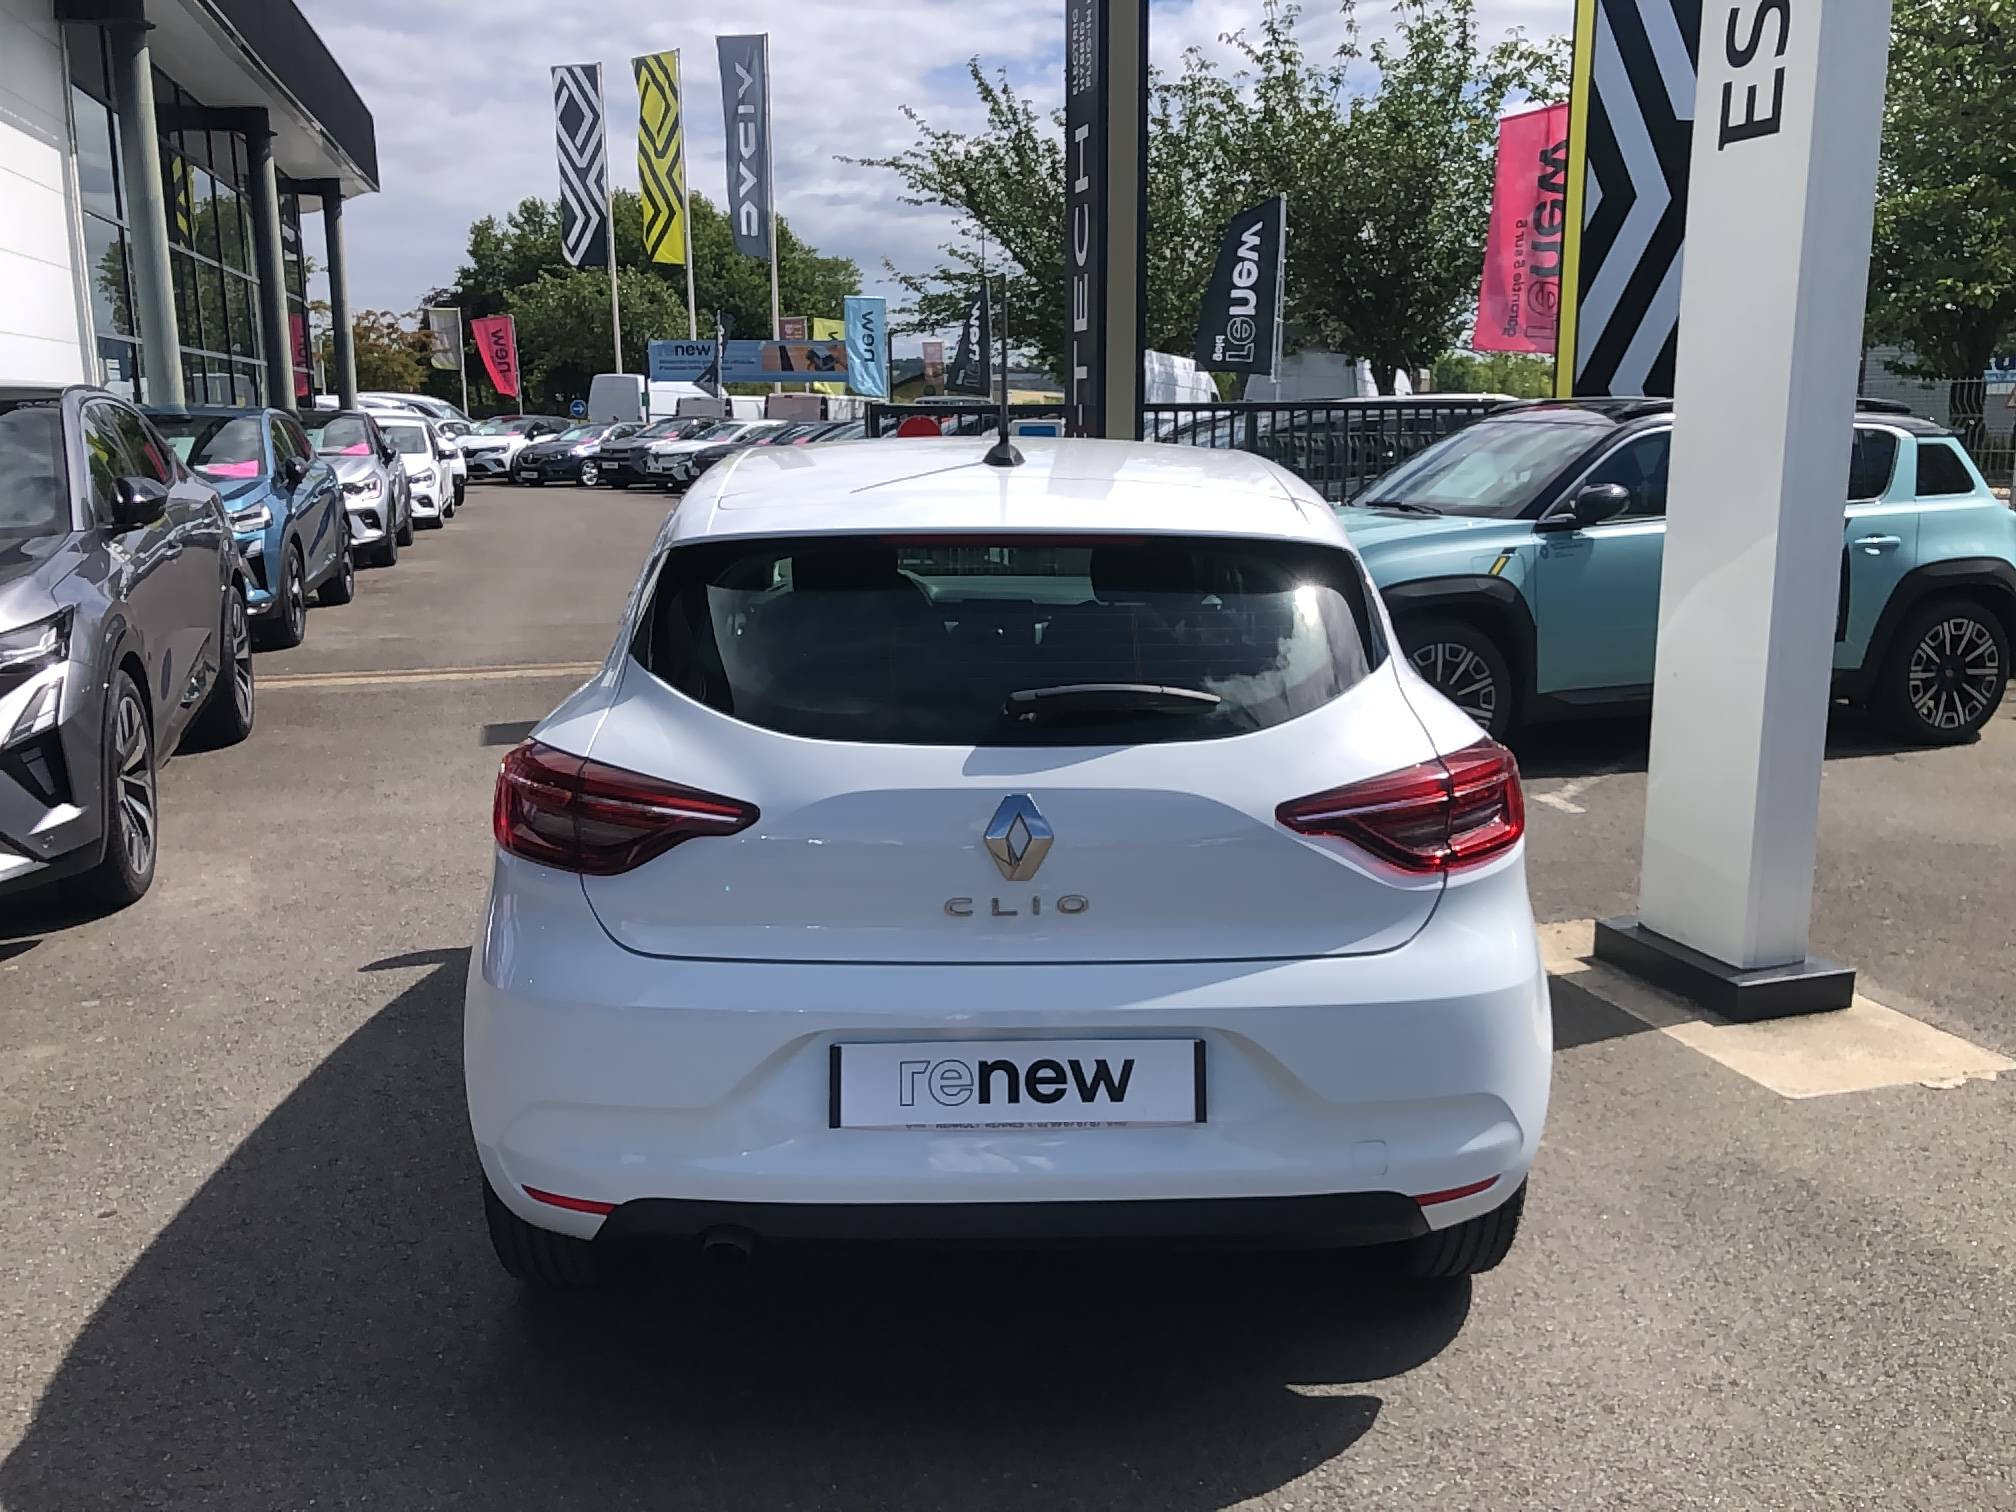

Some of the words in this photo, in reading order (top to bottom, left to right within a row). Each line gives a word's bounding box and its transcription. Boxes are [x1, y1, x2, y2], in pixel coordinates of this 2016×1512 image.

[1718, 0, 1791, 151] ES
[1073, 123, 1089, 438] -TECH
[944, 895, 1089, 917] CLIO
[899, 1058, 1135, 1106] renew
